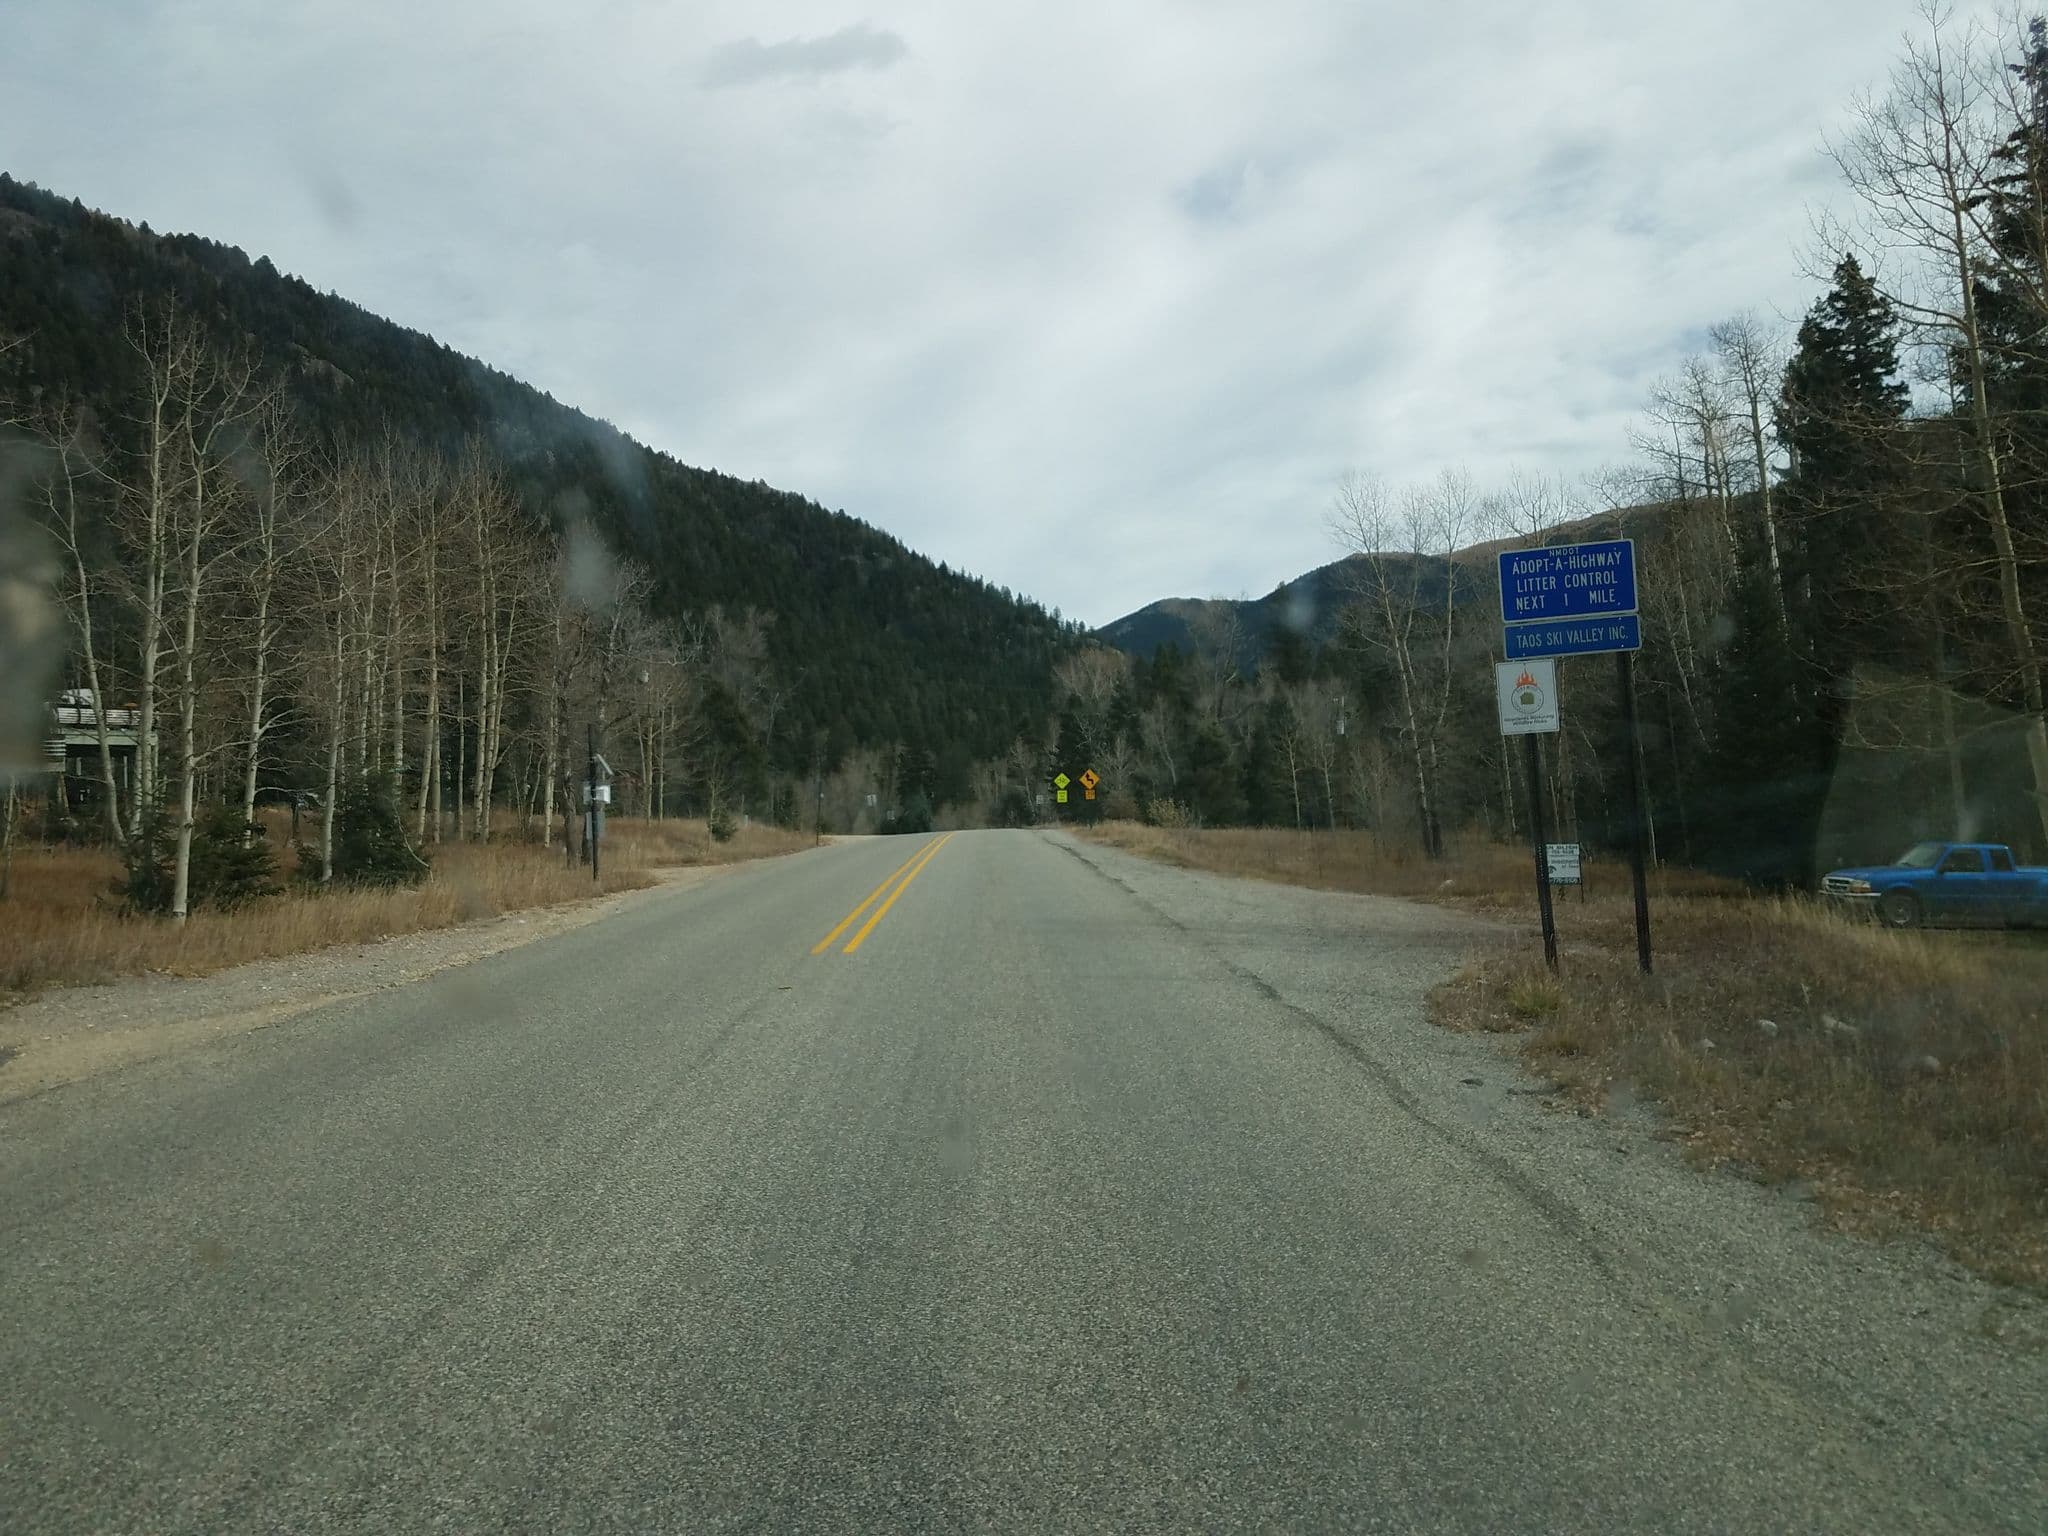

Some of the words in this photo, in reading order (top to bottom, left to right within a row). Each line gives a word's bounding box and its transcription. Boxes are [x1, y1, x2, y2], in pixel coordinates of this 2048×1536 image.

[1549, 547, 1579, 556] NMDOT
[1512, 552, 1622, 575] ADOPT-A-HIGHWAY
[1517, 576, 1556, 593] LITTER
[1564, 571, 1618, 588] CONTROL
[1516, 595, 1545, 611] NEXT
[1563, 593, 1569, 606] 1
[1589, 589, 1616, 605] MILE
[1516, 633, 1542, 648] TAOS
[1546, 630, 1562, 646] SKI
[1567, 627, 1604, 644] VALLEY
[1609, 626, 1628, 640] INC.
